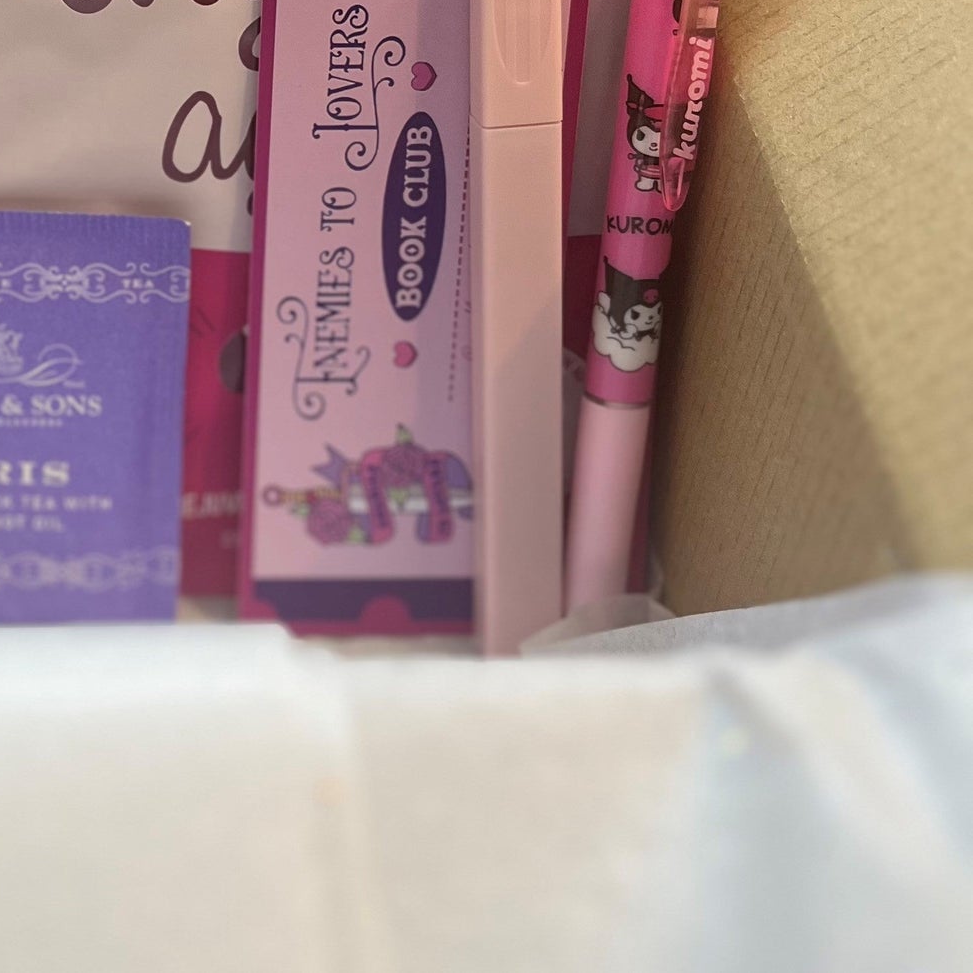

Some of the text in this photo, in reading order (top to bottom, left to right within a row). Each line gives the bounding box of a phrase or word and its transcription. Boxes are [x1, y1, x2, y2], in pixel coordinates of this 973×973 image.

[673, 36, 712, 161] kuromi
[277, 3, 407, 421] ENEMIES TO LOVERS
[396, 125, 435, 310] BOOK CLUB
[0, 393, 25, 416] &
[30, 394, 103, 417] SONS
